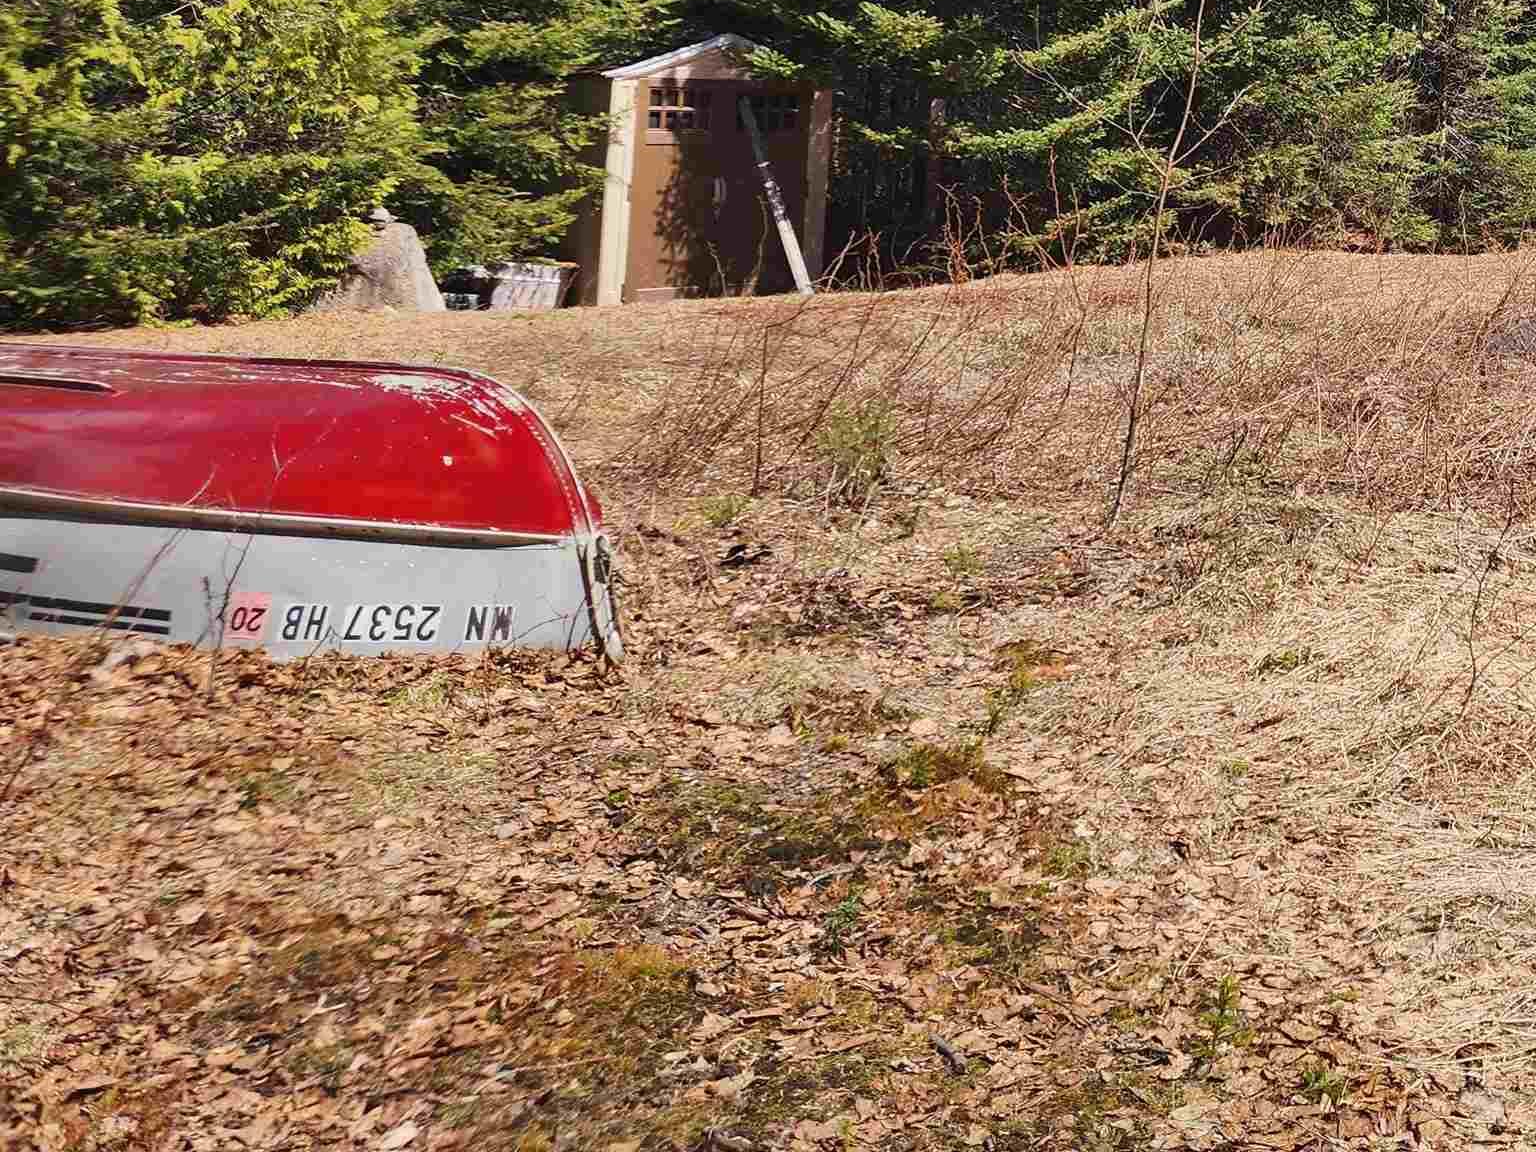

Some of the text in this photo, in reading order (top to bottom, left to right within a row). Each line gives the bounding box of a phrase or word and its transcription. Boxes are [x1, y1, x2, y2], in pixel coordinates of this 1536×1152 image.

[230, 606, 266, 631] 20
[282, 605, 513, 640] MN 2537 HB
